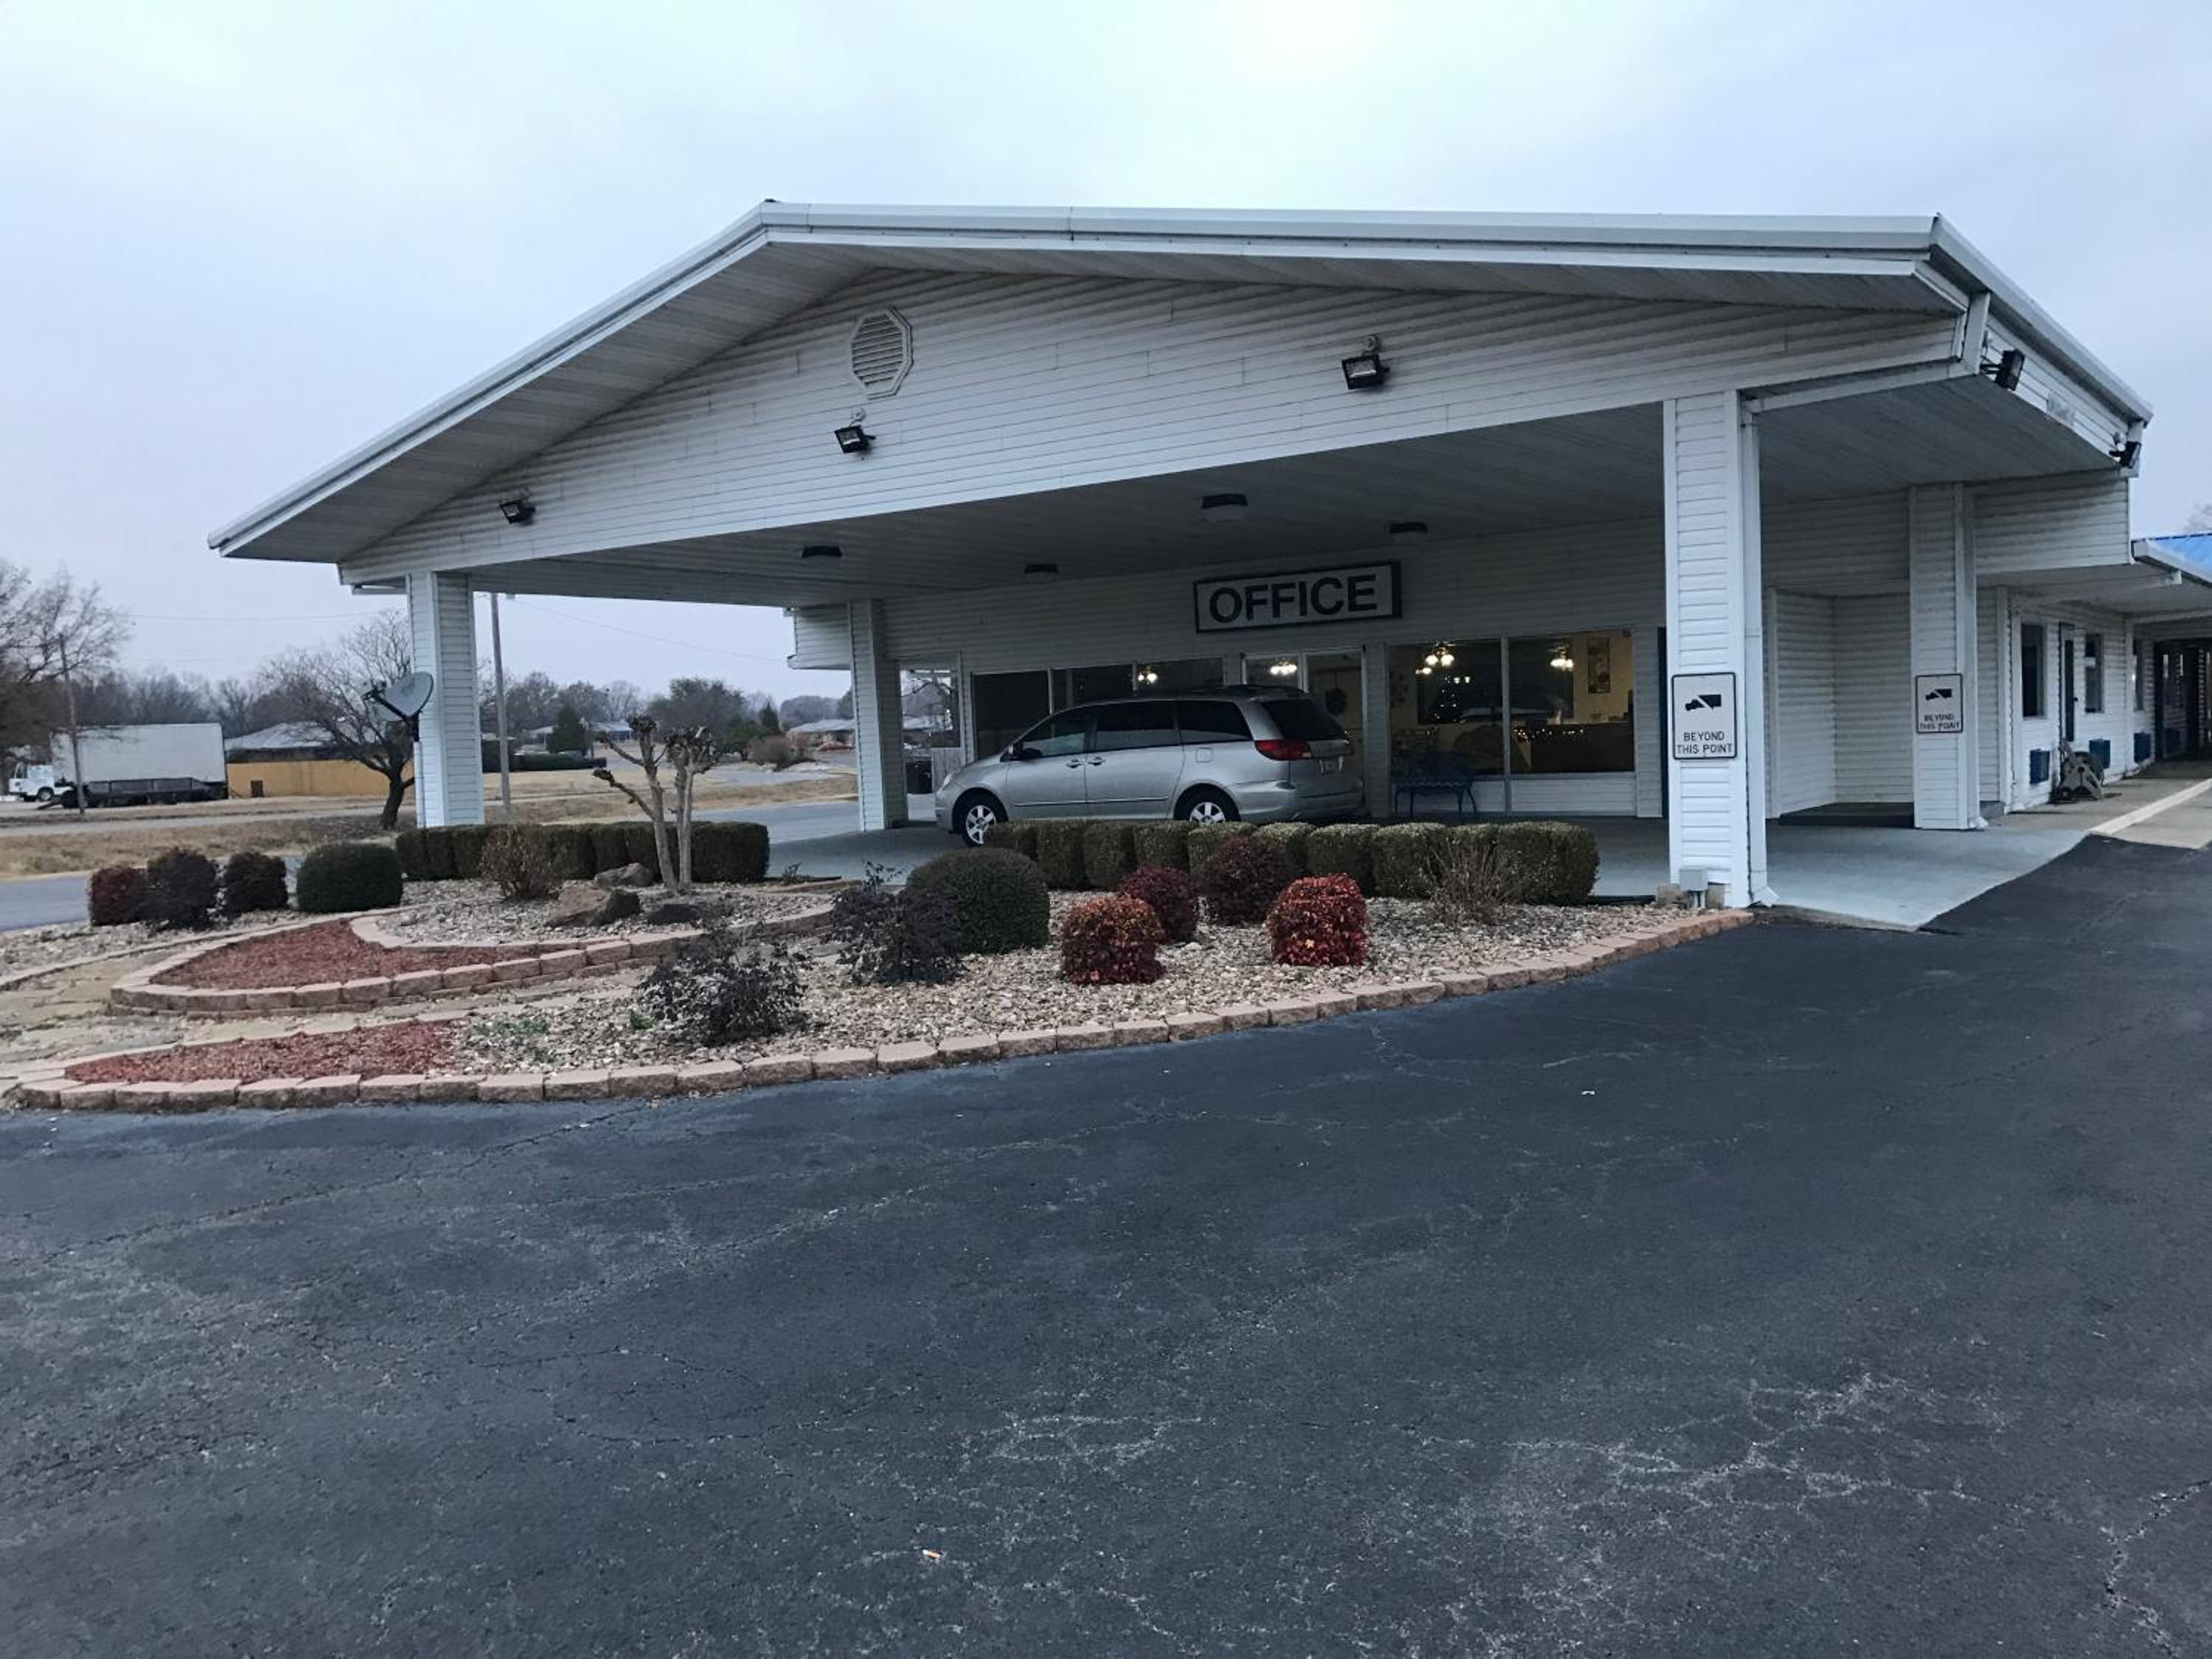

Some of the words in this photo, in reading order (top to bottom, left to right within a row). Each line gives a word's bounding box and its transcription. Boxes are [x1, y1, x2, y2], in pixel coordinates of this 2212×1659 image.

[1209, 574, 1377, 623] OFFICE
[1683, 731, 1725, 742] BEYOND
[1677, 744, 1700, 754] THIS
[1703, 743, 1733, 753] POINT
